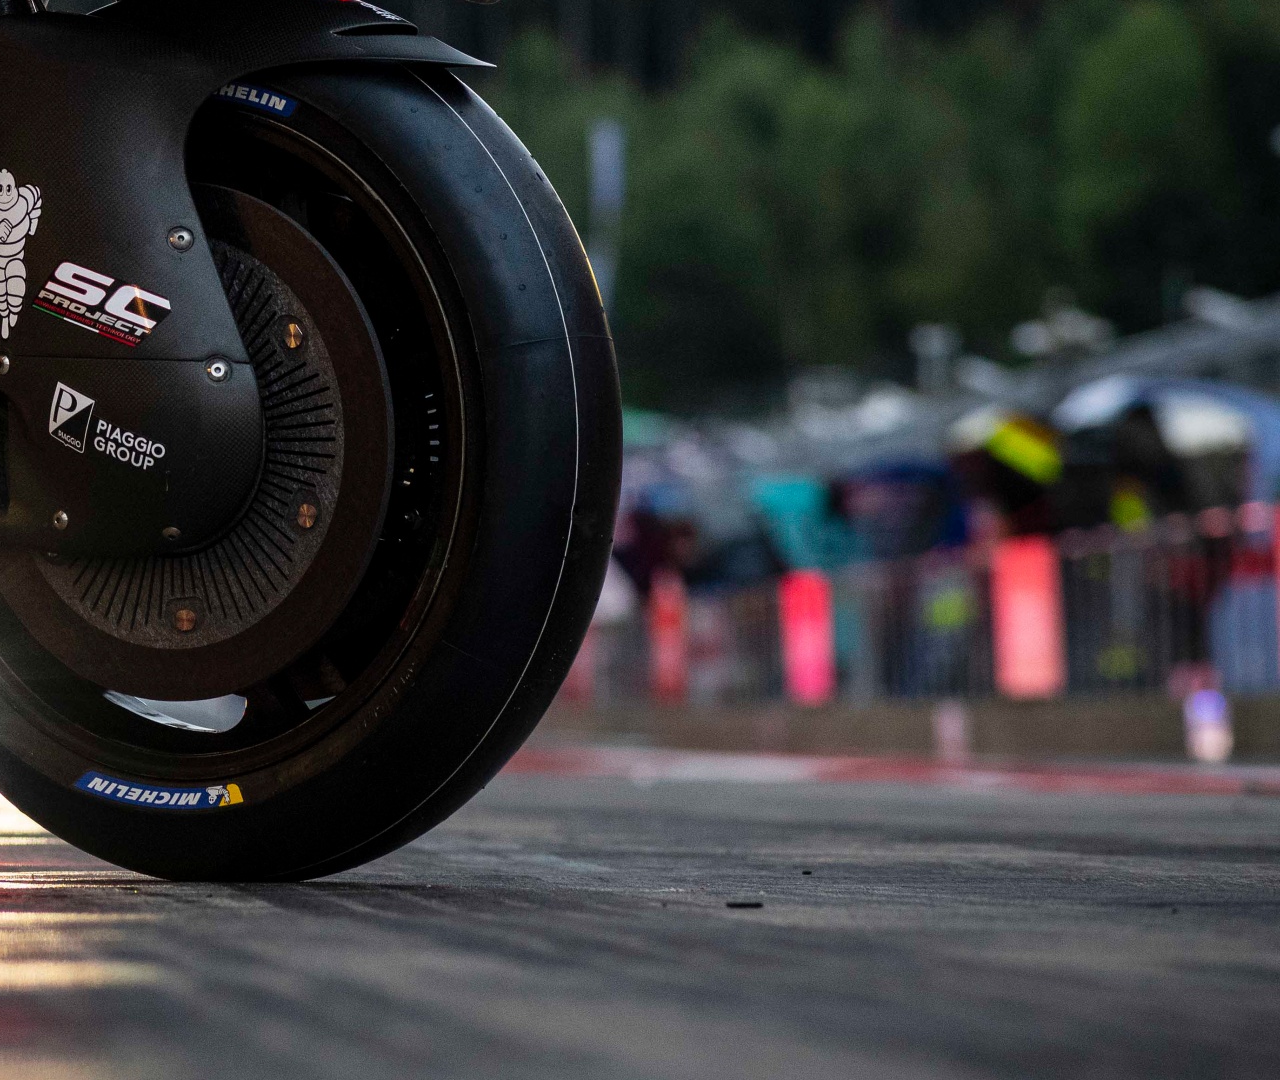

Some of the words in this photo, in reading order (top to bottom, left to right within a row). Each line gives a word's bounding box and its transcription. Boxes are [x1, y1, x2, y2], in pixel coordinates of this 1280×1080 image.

[214, 84, 287, 111] HELIN
[45, 262, 171, 329] SC
[38, 289, 151, 336] PROJECT
[95, 323, 141, 344] TECHNOLOGY
[57, 430, 82, 448] PIAGGIO
[93, 436, 155, 470] GROUP
[96, 420, 166, 459] PIAGGIO
[87, 776, 202, 806] MICHELIN
